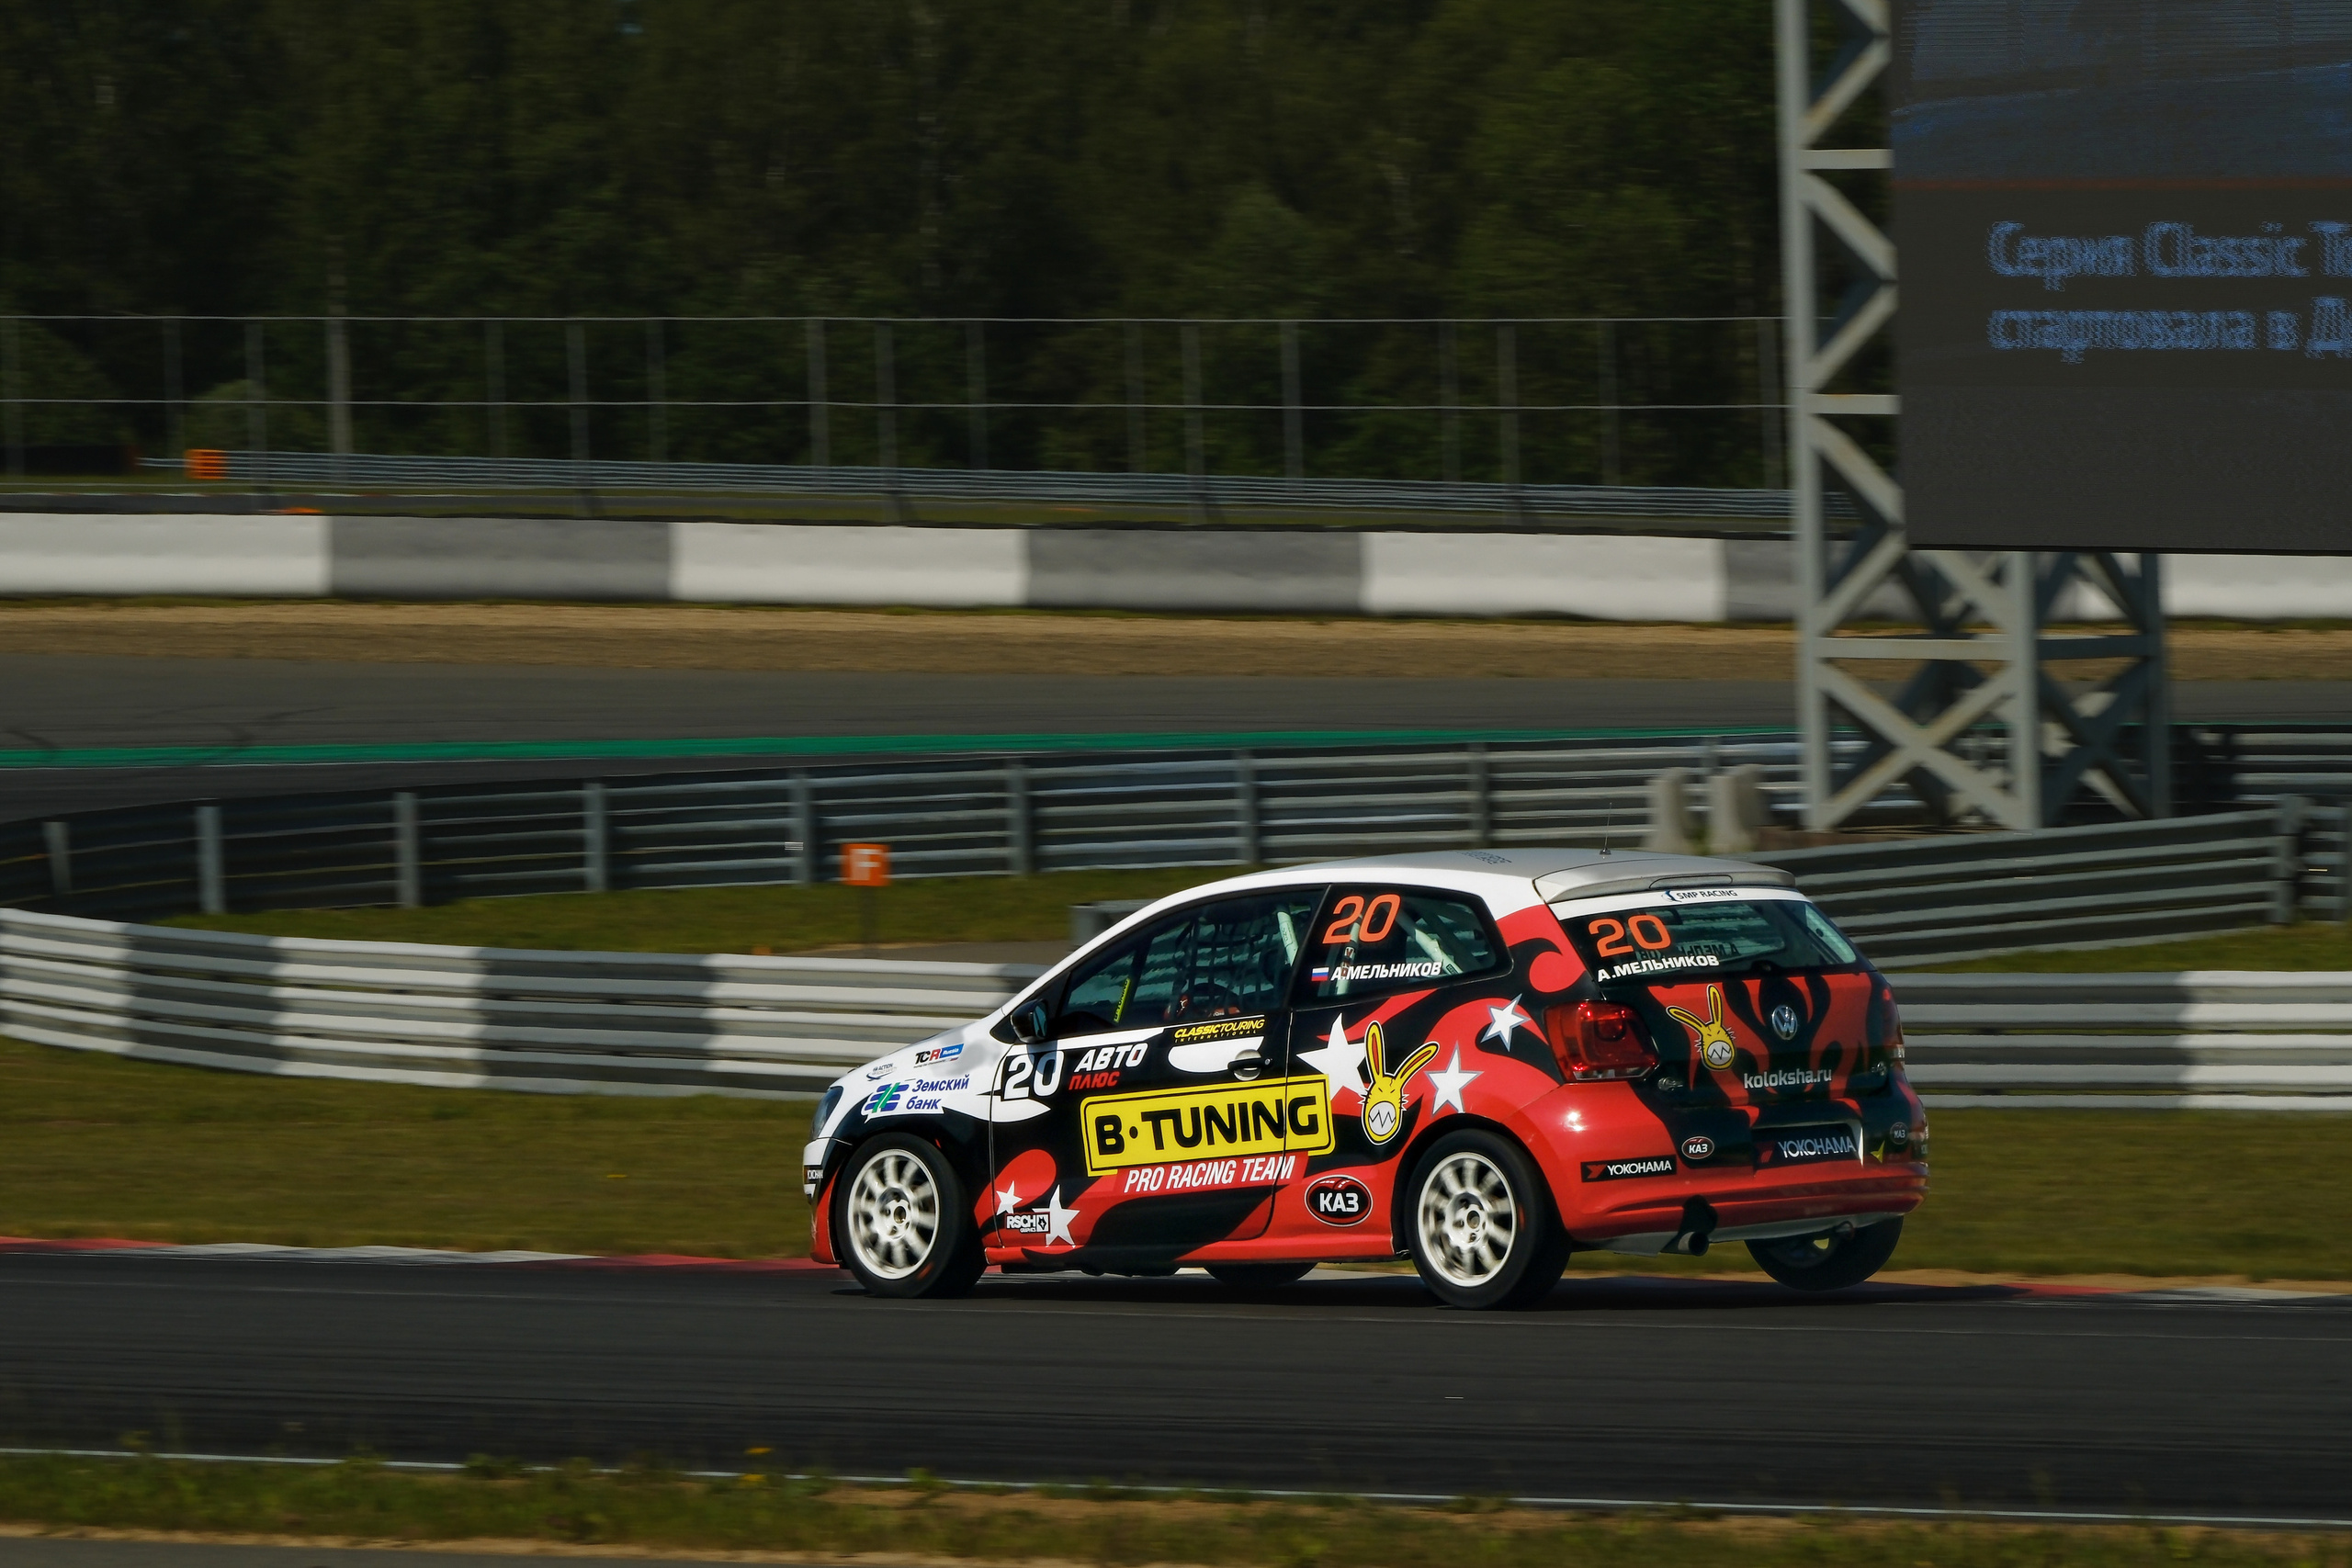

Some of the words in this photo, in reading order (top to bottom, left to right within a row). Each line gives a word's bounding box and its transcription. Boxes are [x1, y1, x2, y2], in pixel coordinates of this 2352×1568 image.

[1987, 220, 2136, 292] Серия
[2143, 220, 2308, 277] Classic
[1987, 310, 2258, 364] стартовала
[2266, 310, 2301, 350] в
[1676, 891, 1698, 900] SMP
[1702, 889, 1738, 898] RACING
[1322, 893, 1401, 944] 20
[1588, 914, 1671, 958] 20
[1330, 961, 1442, 981] А.МЕЛЬНИКОВ
[1598, 954, 1720, 982] А.МЕЛЬНИКОВ
[915, 1048, 941, 1065] TCR
[1074, 1043, 1148, 1073] АВТО
[912, 1074, 970, 1092] Земский
[1003, 1050, 1065, 1100] 20
[1069, 1071, 1120, 1090] ПЛЮС
[1744, 1068, 1832, 1089] koloksha.ru
[906, 1096, 942, 1110] банк
[1778, 1135, 1856, 1158] YOKOHAMA
[1124, 1167, 1164, 1193] PRO
[1166, 1160, 1237, 1189] RACING
[1241, 1155, 1296, 1182] TEAM
[1607, 1160, 1672, 1176] YOKOHAMA
[1006, 1214, 1036, 1229] RSCH
